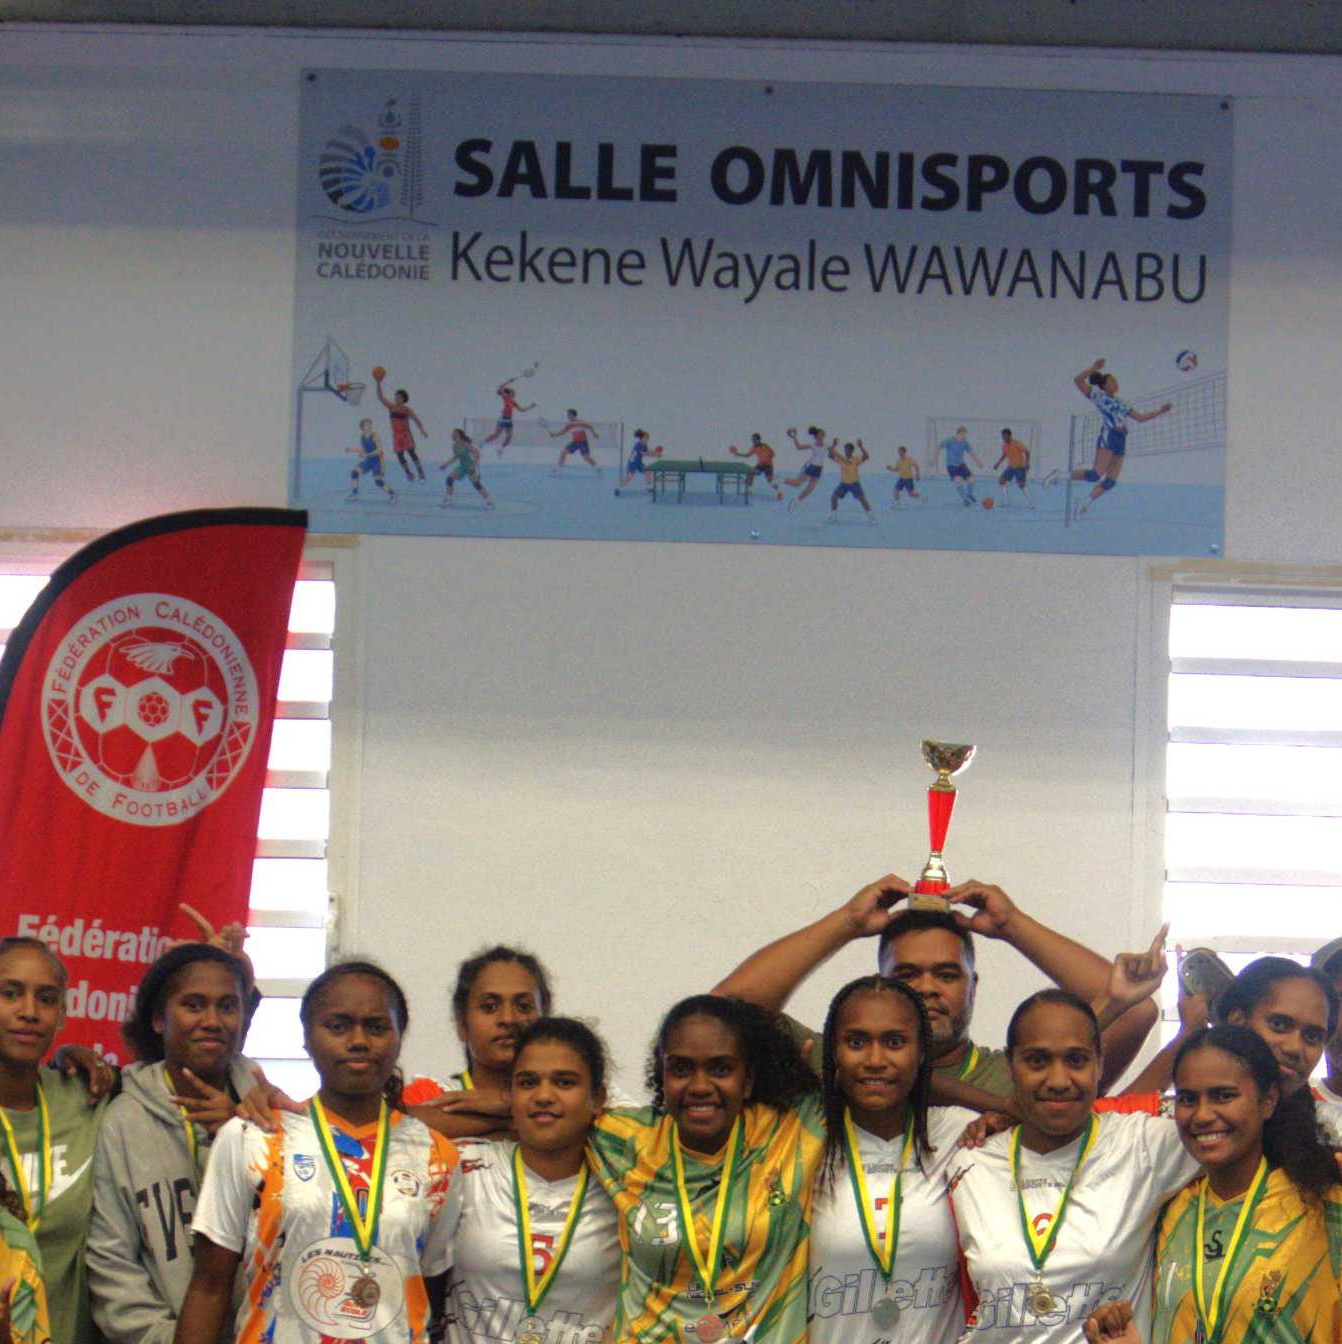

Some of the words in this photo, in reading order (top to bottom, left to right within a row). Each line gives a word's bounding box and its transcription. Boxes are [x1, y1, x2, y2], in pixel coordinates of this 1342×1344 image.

[453, 137, 679, 203] SALLE
[710, 144, 1208, 221] OMNISPORTS
[316, 259, 431, 281] CALÉDONIE
[318, 242, 431, 261] NOUVELLE
[451, 230, 646, 287] Kekene
[661, 237, 851, 304] Wayale
[864, 243, 1208, 304] WAWANABU
[52, 603, 141, 694] FÉDÉRATION
[154, 601, 250, 715] CALÉDONIENNE
[74, 770, 101, 797] DE
[111, 788, 210, 818] FOOTBALL
[634, 1201, 680, 1246] 13
